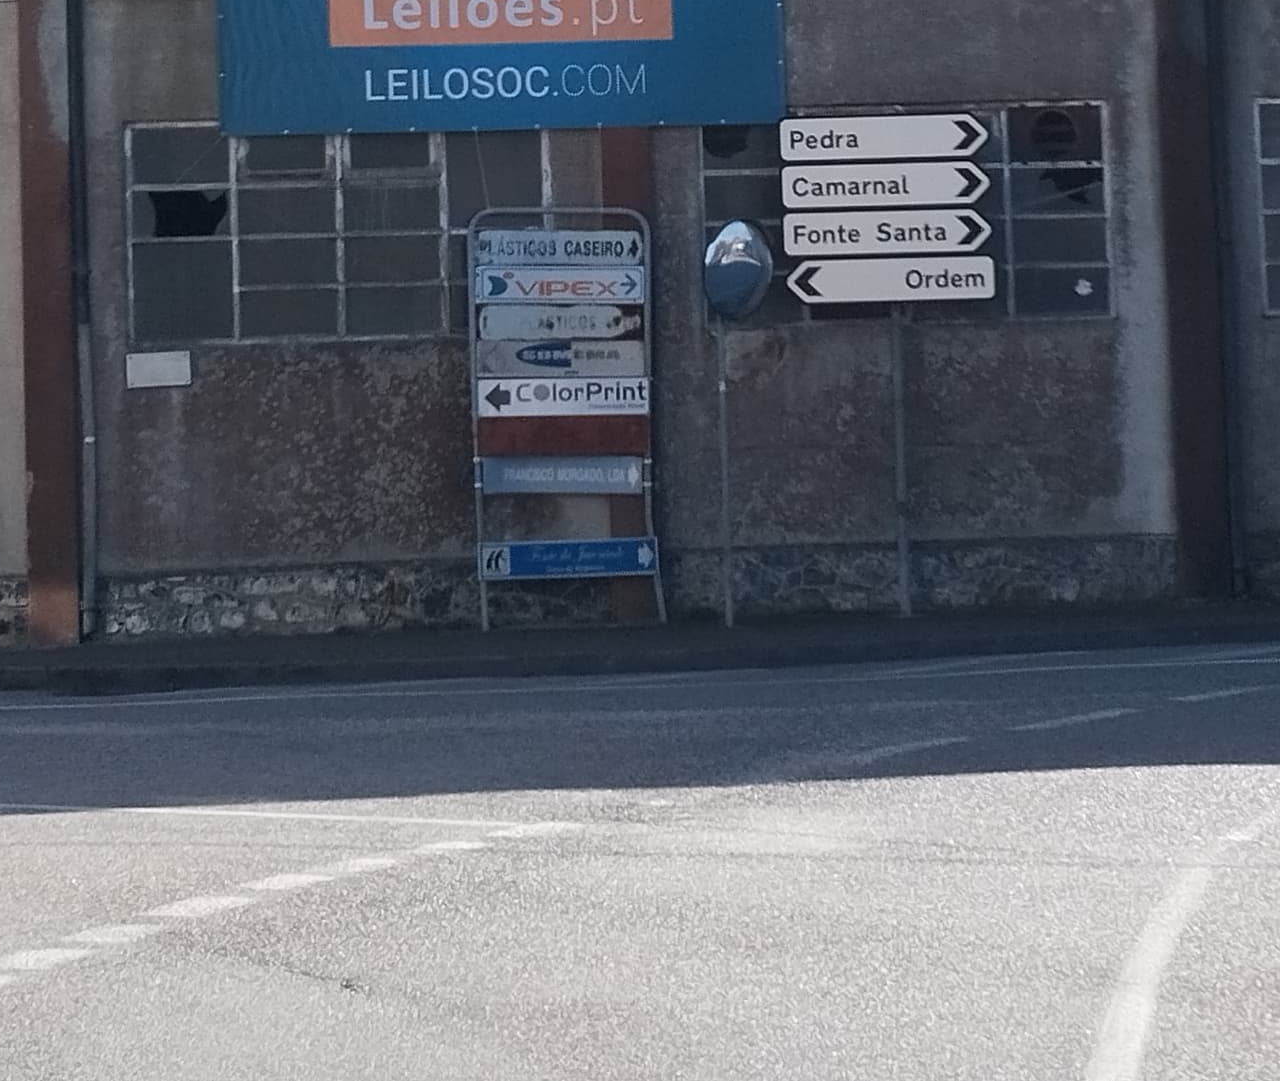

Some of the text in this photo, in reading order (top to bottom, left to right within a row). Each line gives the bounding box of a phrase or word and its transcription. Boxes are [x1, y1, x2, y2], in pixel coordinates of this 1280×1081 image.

[365, 63, 647, 101] LEILOSOC.COM
[790, 130, 859, 150] Pedra
[792, 175, 910, 197] Camarnal
[794, 223, 948, 244] Fonte Santa
[515, 280, 618, 296] VIPEX
[905, 269, 985, 290] Ordem
